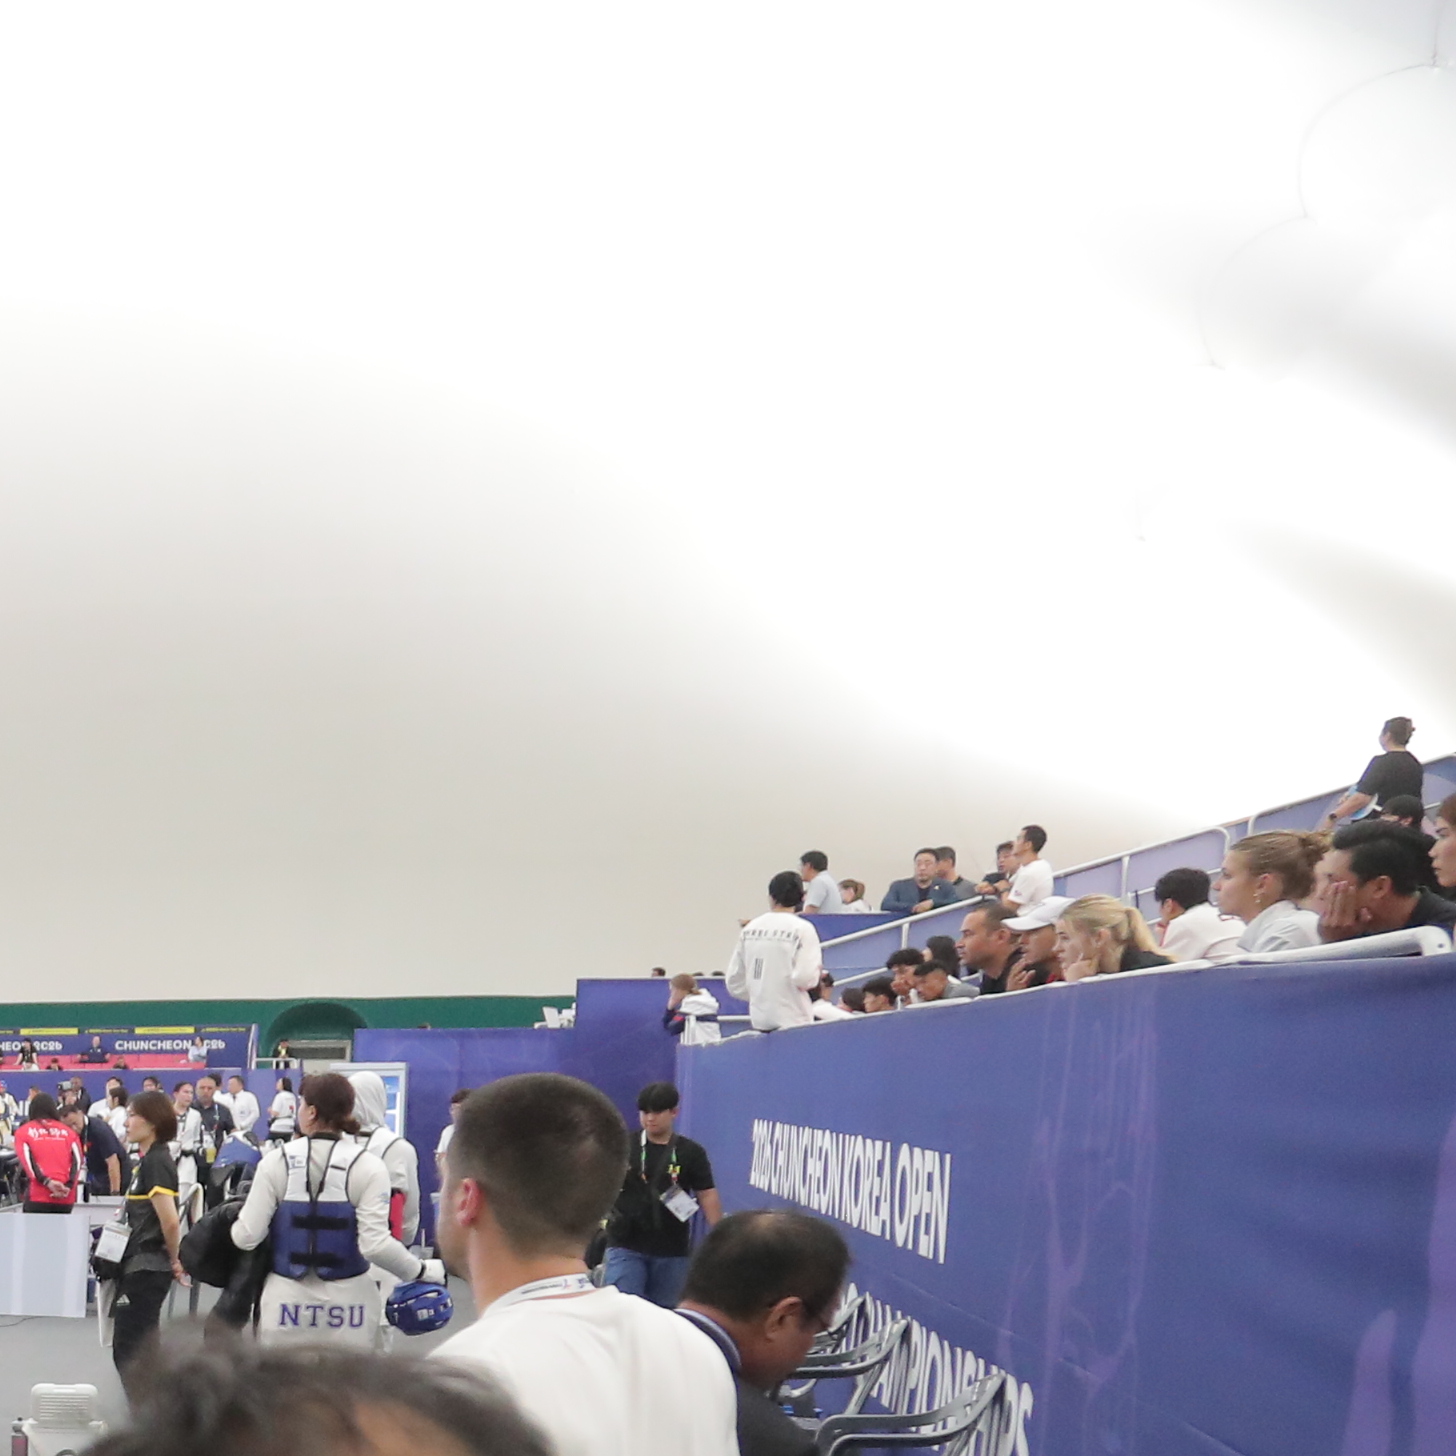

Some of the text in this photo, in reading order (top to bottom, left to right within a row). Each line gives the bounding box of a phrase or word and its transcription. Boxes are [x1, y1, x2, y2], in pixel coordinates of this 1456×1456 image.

[772, 1121, 840, 1220] CHUNCHEON
[841, 1134, 892, 1241] KOREA
[895, 1142, 952, 1265] OPEN
[279, 1303, 365, 1328] NTSU
